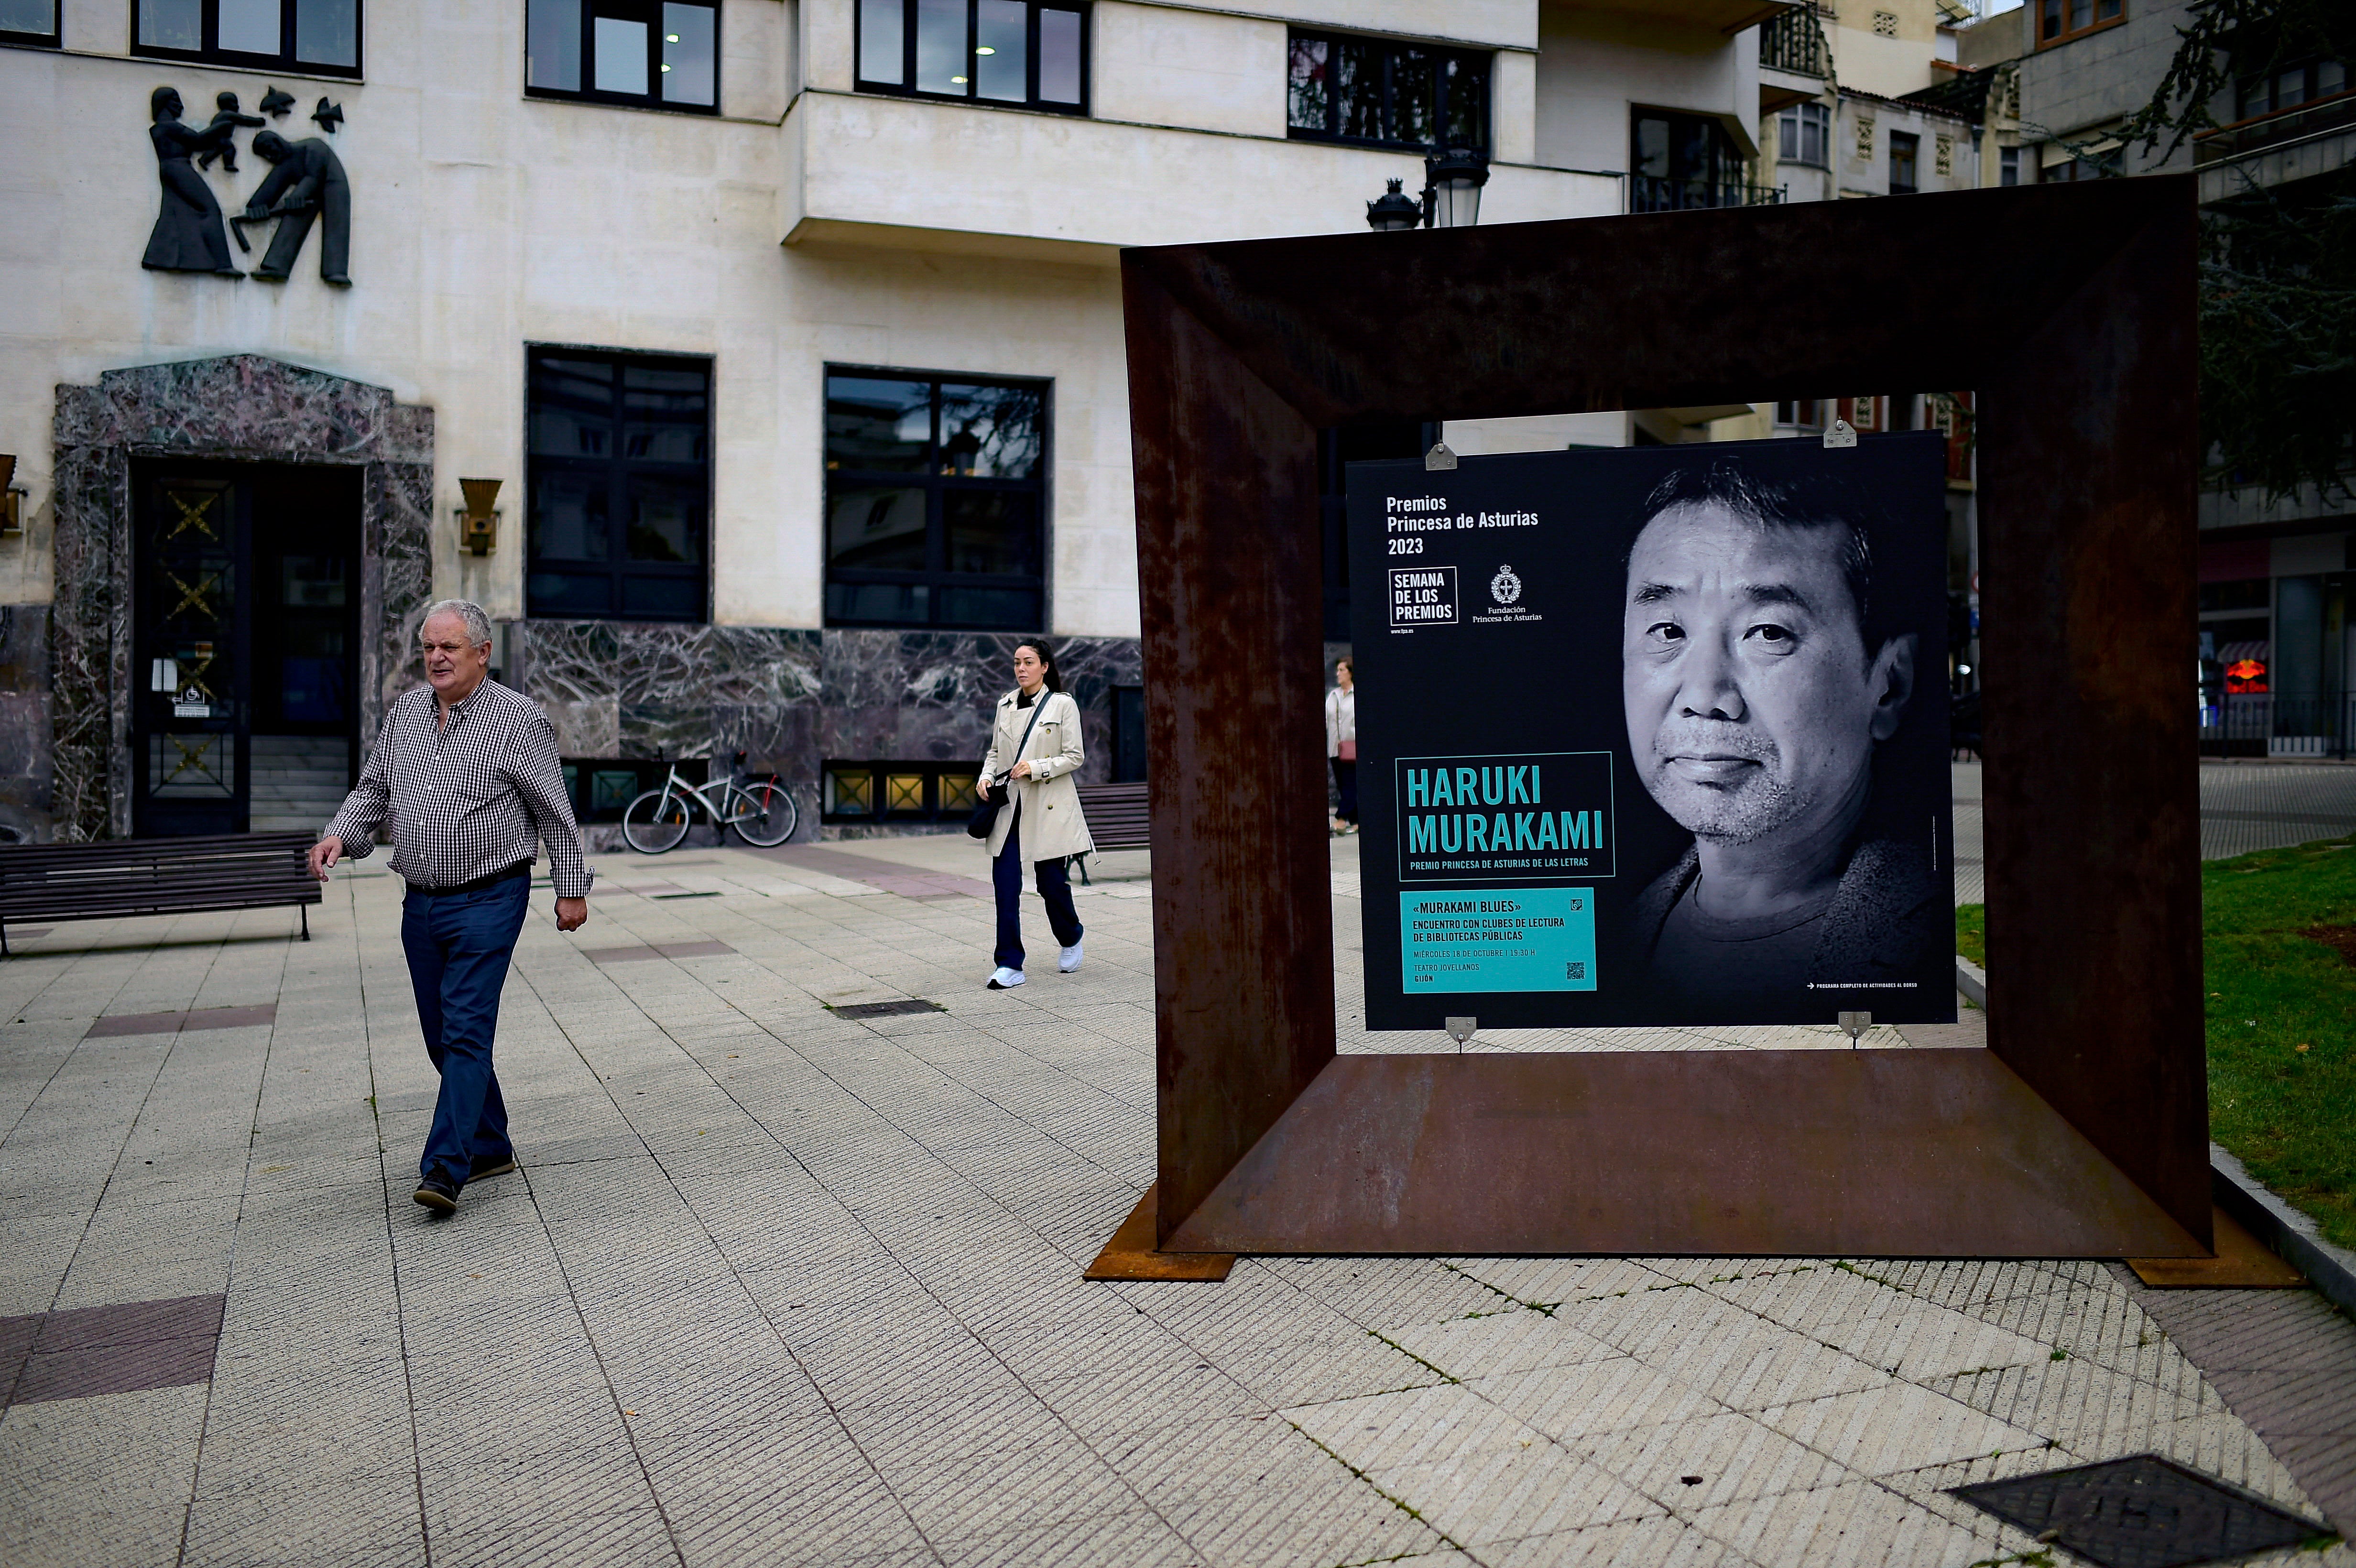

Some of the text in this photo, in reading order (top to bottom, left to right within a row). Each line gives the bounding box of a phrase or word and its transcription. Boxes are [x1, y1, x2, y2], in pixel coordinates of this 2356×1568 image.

[1386, 495, 1447, 512] Premios
[1387, 511, 1538, 532] Princesa de Asturias
[1388, 538, 1423, 555] 2023
[1395, 573, 1444, 588] SEMANA
[1396, 589, 1438, 604] DE LOS
[1396, 604, 1452, 620] PREMIOS
[1407, 765, 1540, 806] HARUKI
[1409, 810, 1603, 853] MURAKAMI
[1410, 858, 1588, 870] PREMIO PRINCESA DE ASTURIAS DE LAS LETRAS
[1413, 918, 1565, 929] ENCUENTRO CON CLUBES DE LECTURA
[1414, 929, 1523, 942] DE BIBLIOTECAS PÚBLICAS
[1414, 949, 1451, 958] MIÉRCOLES
[1414, 974, 1433, 982] GIJÓN
